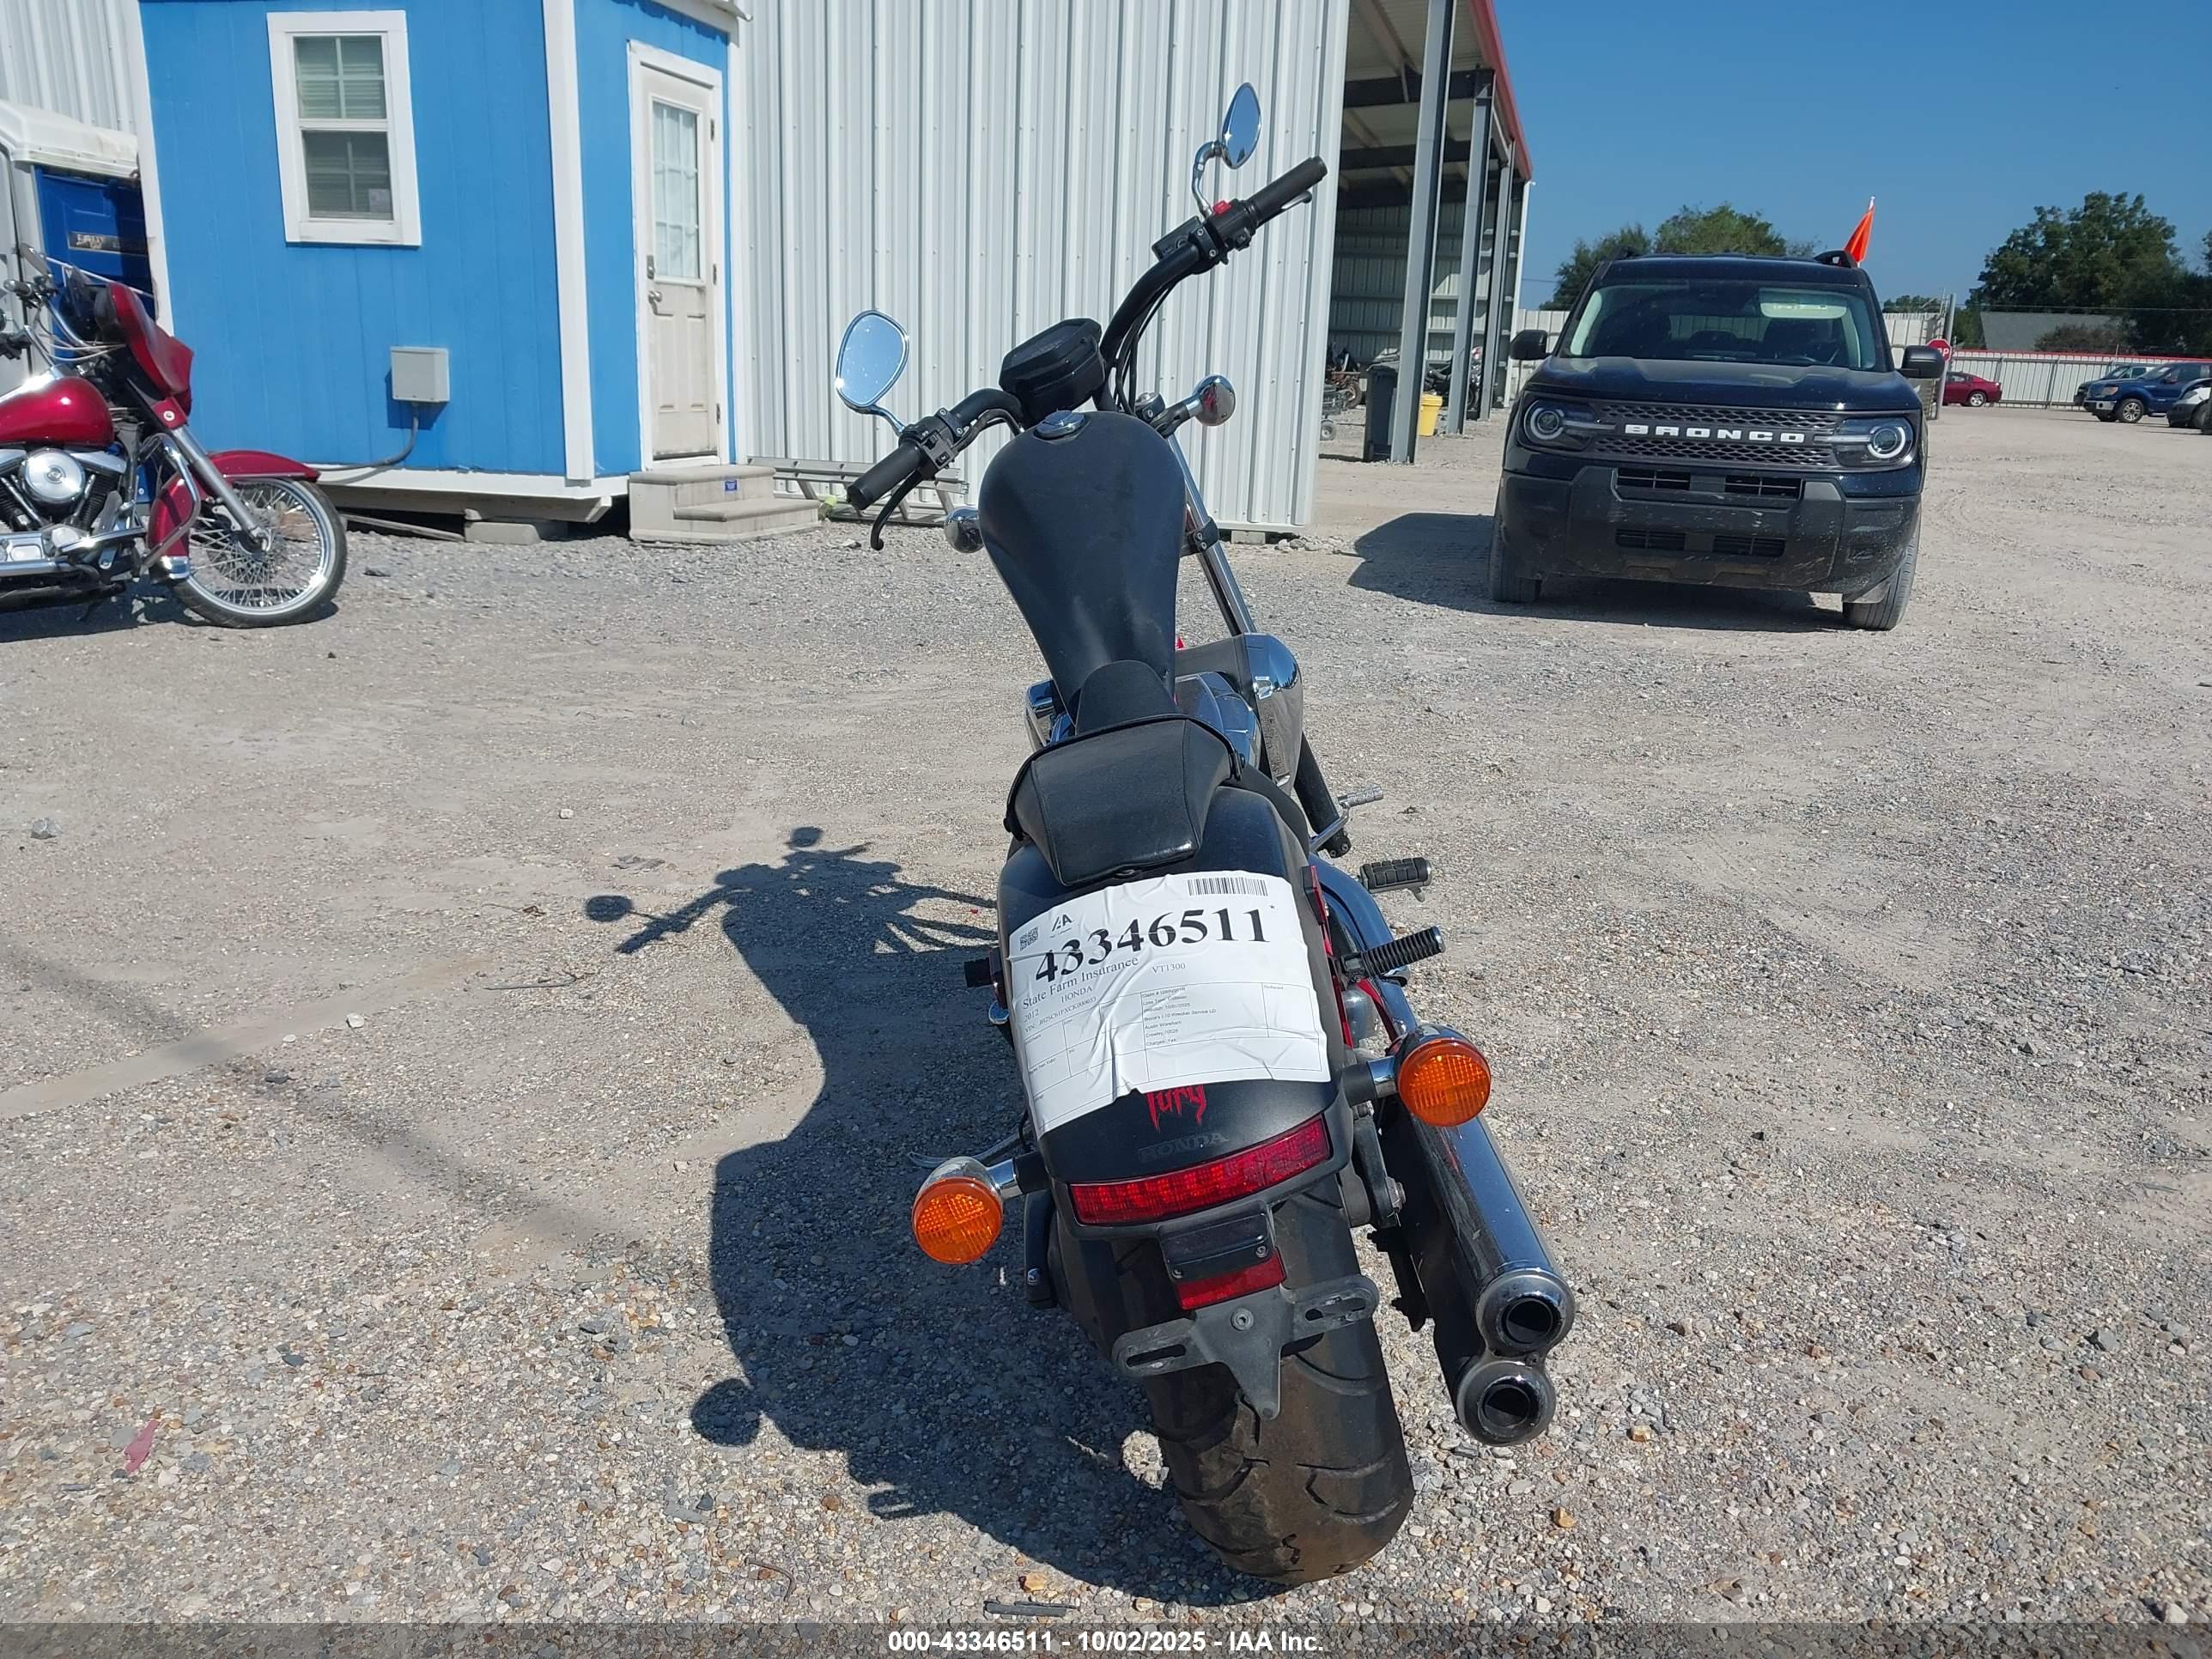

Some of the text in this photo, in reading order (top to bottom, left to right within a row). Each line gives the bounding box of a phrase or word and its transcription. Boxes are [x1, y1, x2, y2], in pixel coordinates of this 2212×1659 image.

[1625, 424, 1804, 443] BRONCO
[1036, 908, 1271, 982] 43346511
[1152, 962, 1186, 974] VT1300
[1023, 957, 1139, 1010] State Farm Insurance
[1060, 985, 1093, 1004] HONDA
[1024, 1009, 1039, 1023] 2012
